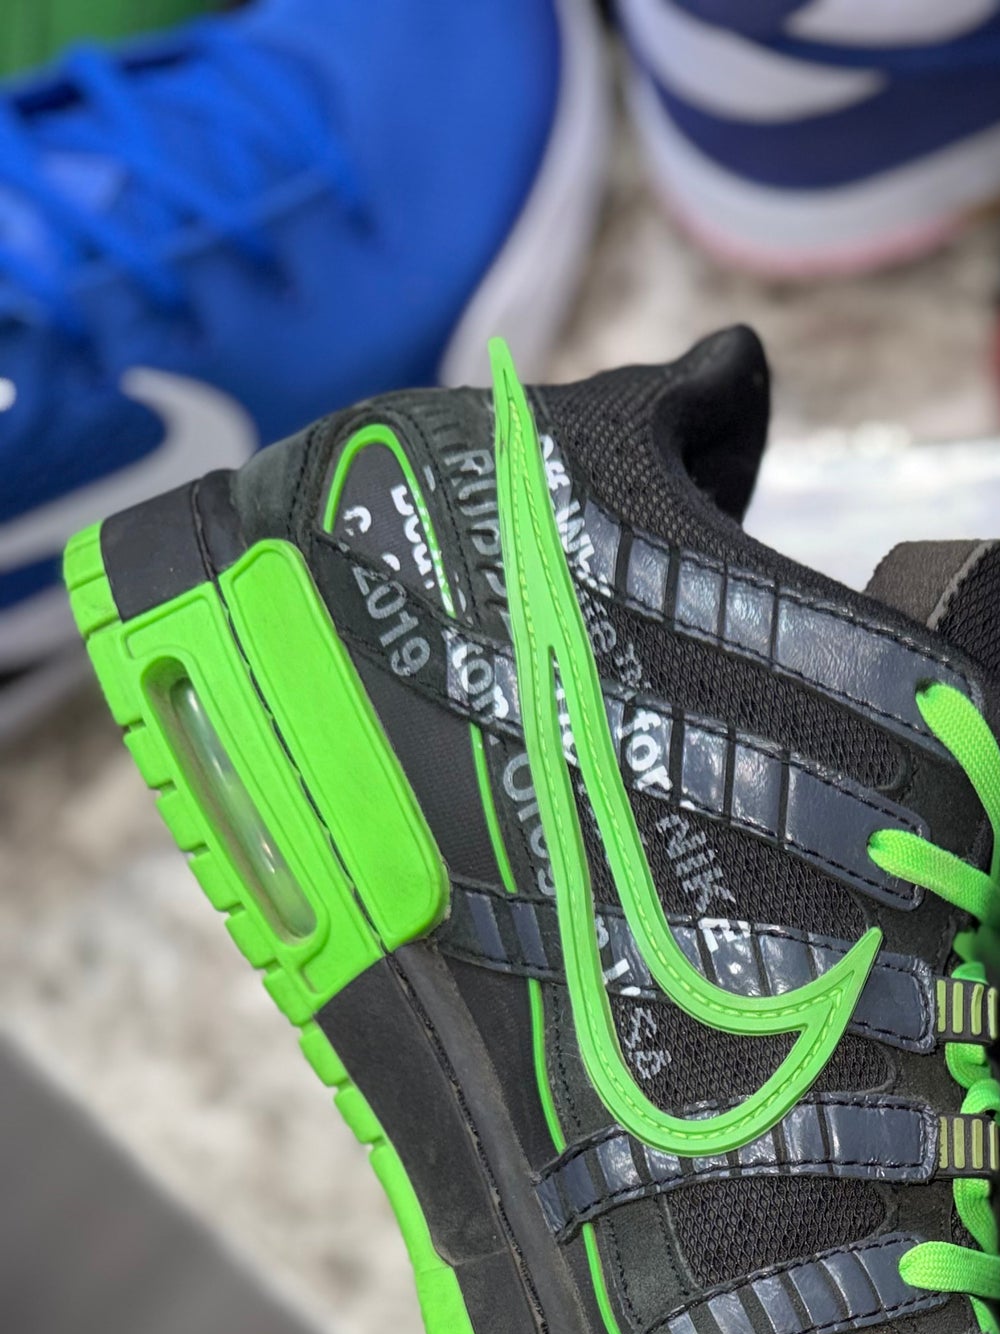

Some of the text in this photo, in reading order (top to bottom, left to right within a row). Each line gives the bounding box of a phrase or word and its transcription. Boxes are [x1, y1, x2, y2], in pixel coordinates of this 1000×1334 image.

[351, 553, 431, 676] 2019
[618, 708, 673, 793] for
[655, 800, 752, 953] NIKE
